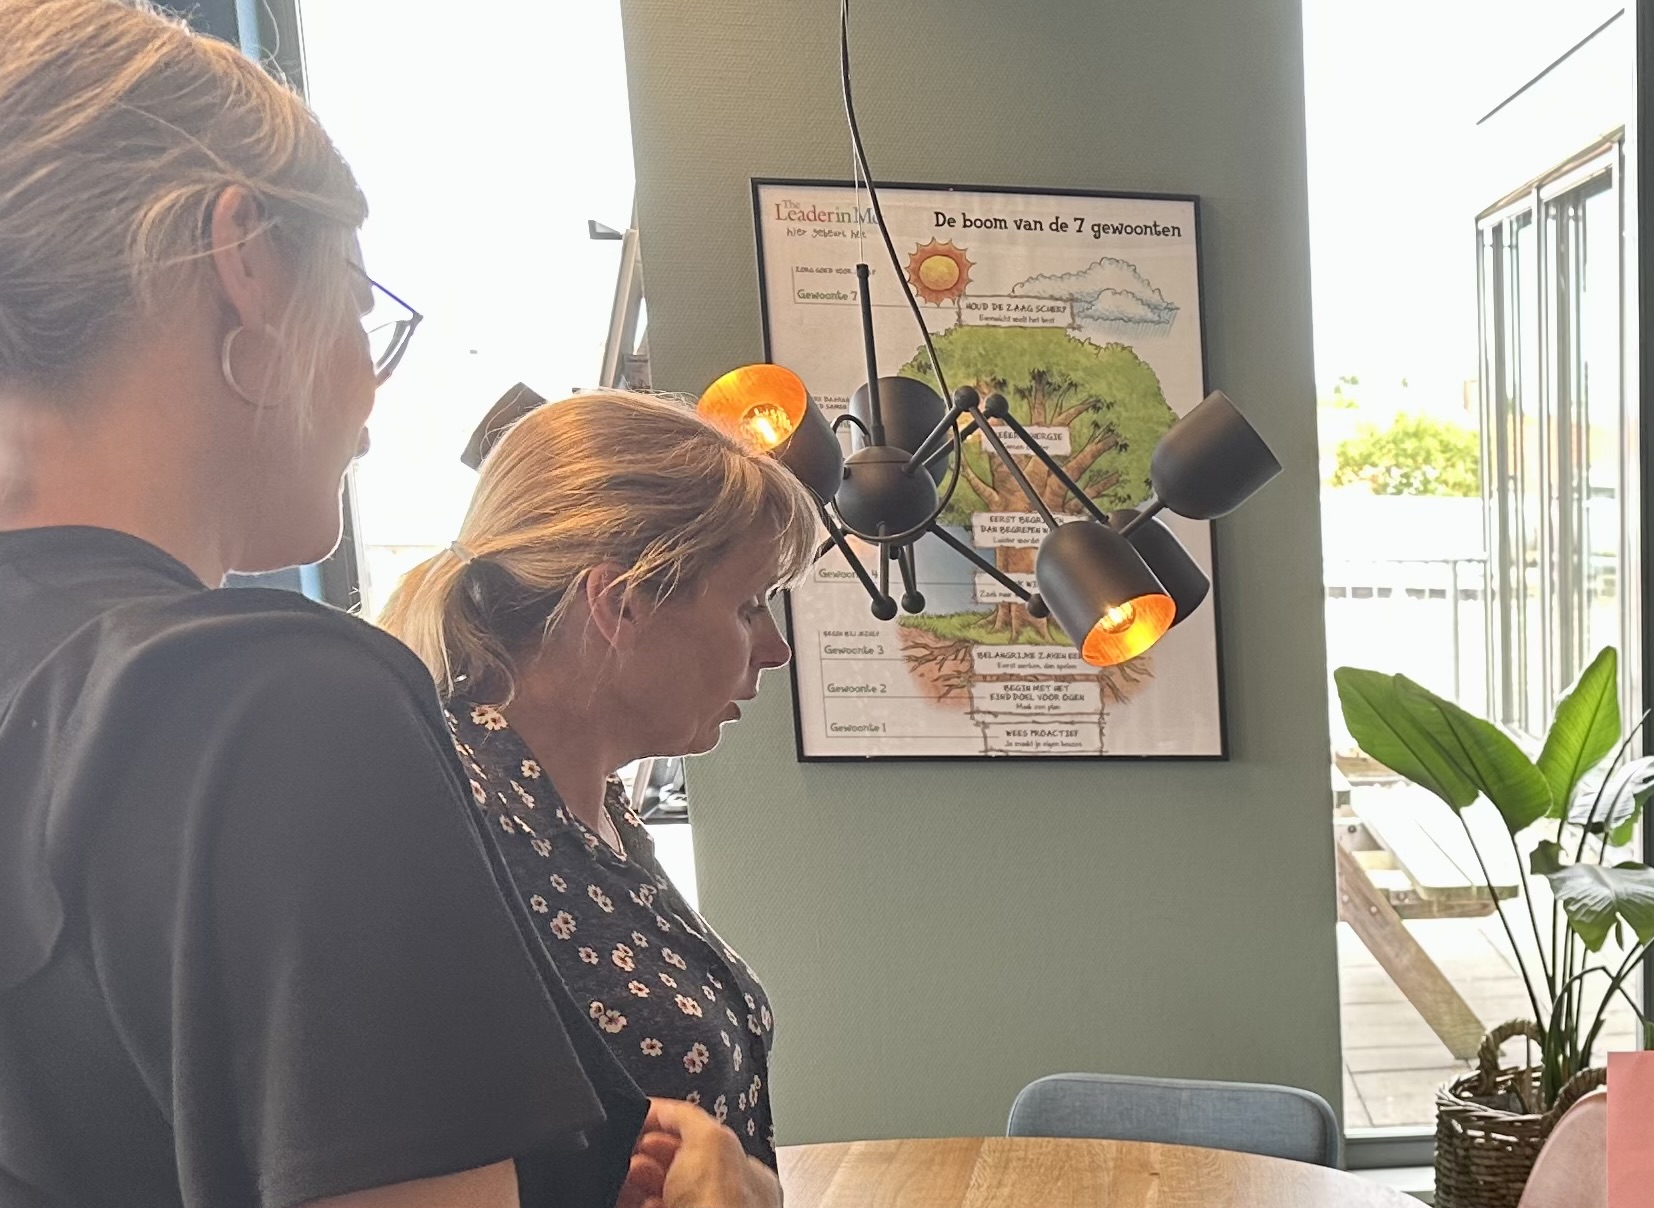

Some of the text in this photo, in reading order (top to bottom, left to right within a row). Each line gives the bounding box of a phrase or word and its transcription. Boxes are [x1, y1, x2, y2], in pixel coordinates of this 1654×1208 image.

[933, 211, 1182, 240] De boom van de 7 gewoonten
[797, 288, 848, 301] Gewoonte
[991, 302, 1004, 311] DE
[823, 644, 884, 656] Gewoonte 3
[827, 683, 887, 694] Gewoonte 2
[829, 722, 880, 732] Gewoonte
